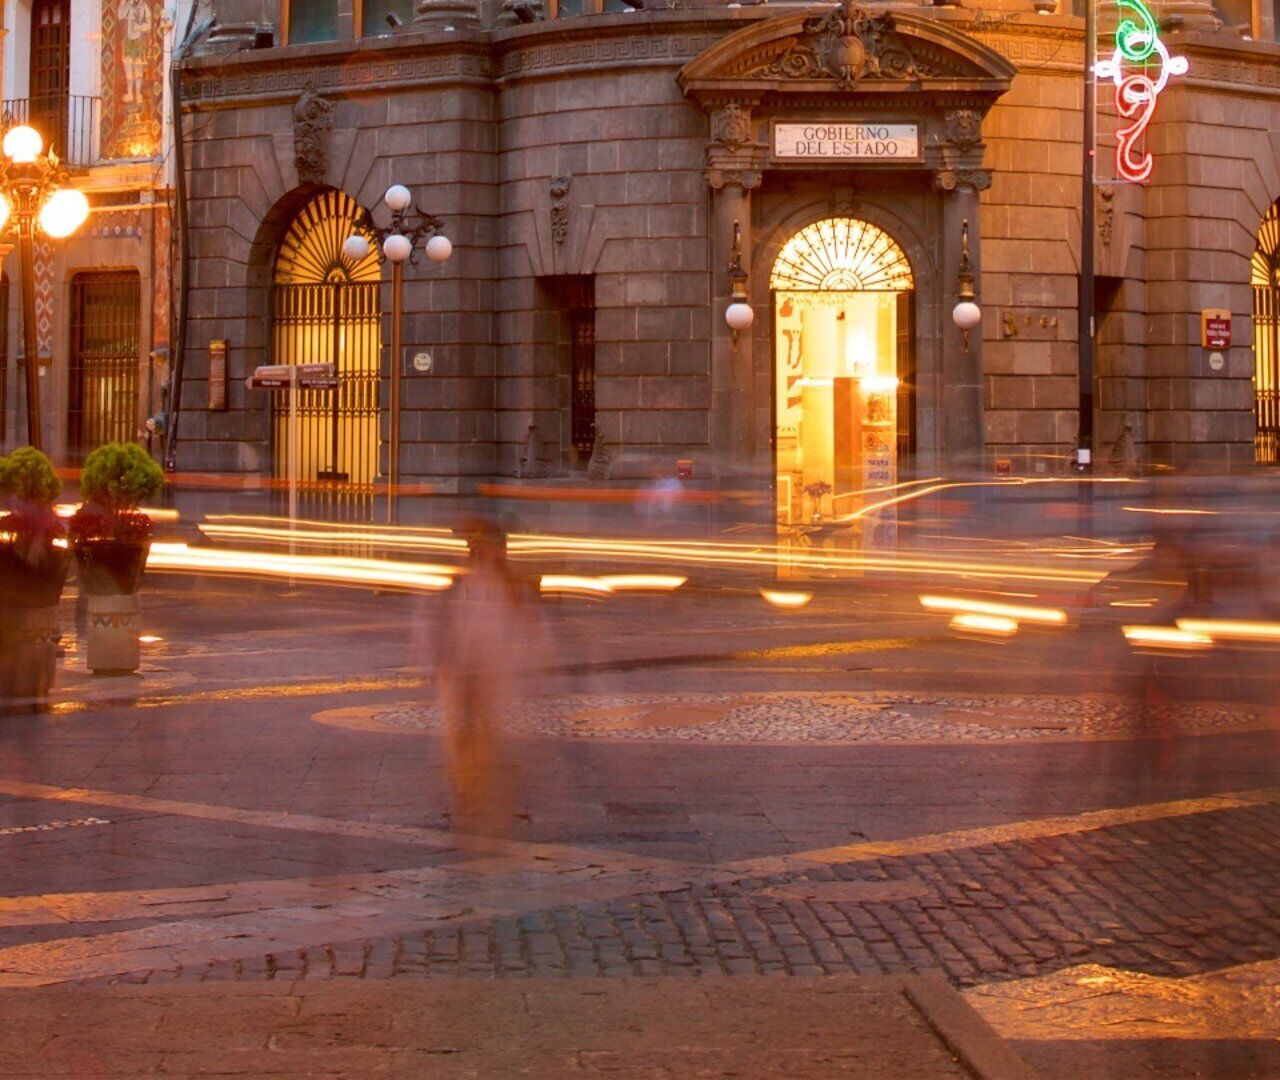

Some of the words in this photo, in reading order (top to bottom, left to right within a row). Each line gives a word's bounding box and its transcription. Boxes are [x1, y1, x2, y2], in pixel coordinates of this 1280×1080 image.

[803, 127, 889, 140] GOBIERNO
[795, 141, 828, 155] DEL
[832, 141, 898, 155] ESTADO
